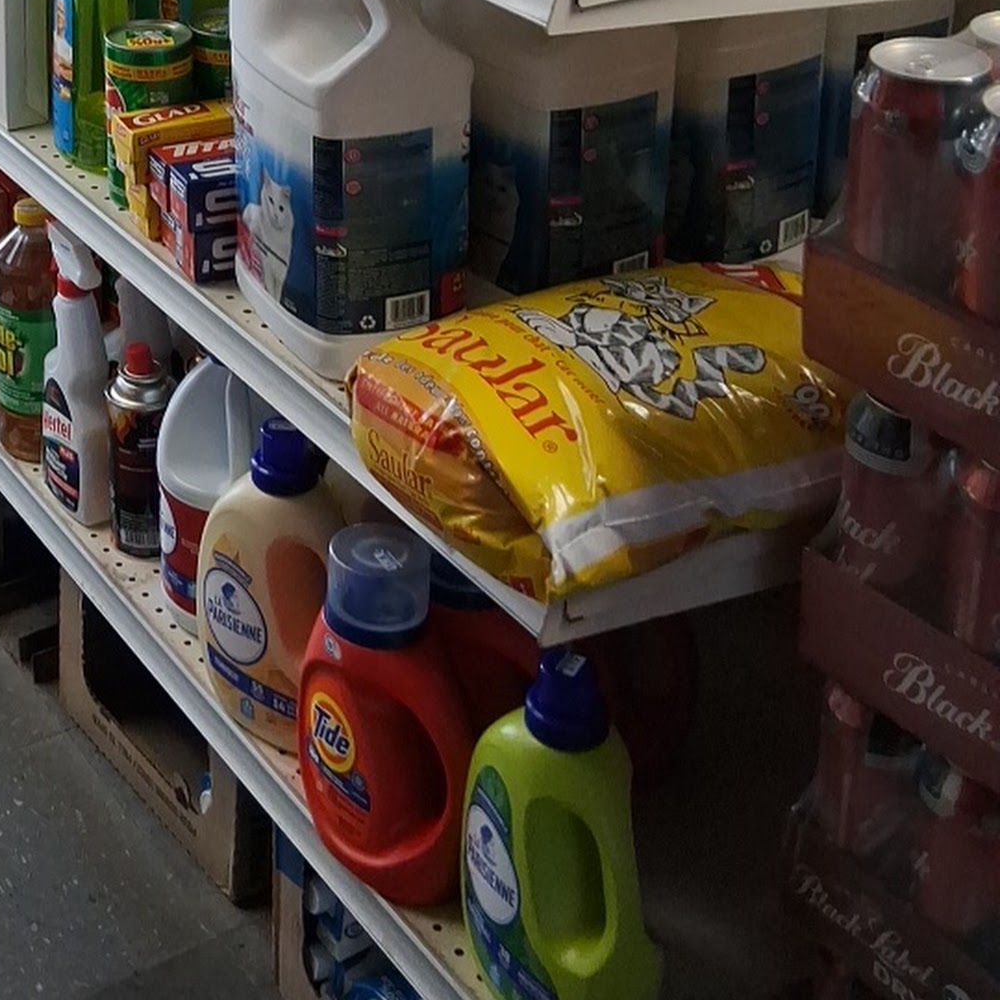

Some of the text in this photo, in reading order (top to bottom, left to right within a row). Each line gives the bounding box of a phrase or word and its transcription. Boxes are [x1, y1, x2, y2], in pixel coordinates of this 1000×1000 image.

[132, 103, 201, 126] GLAD
[162, 138, 234, 158] TITA
[886, 333, 1000, 417] Black
[368, 428, 432, 497] Saular
[838, 500, 901, 555] lack
[208, 602, 264, 645] PARISIENNE
[883, 653, 993, 741] Black
[312, 703, 351, 757] Tide
